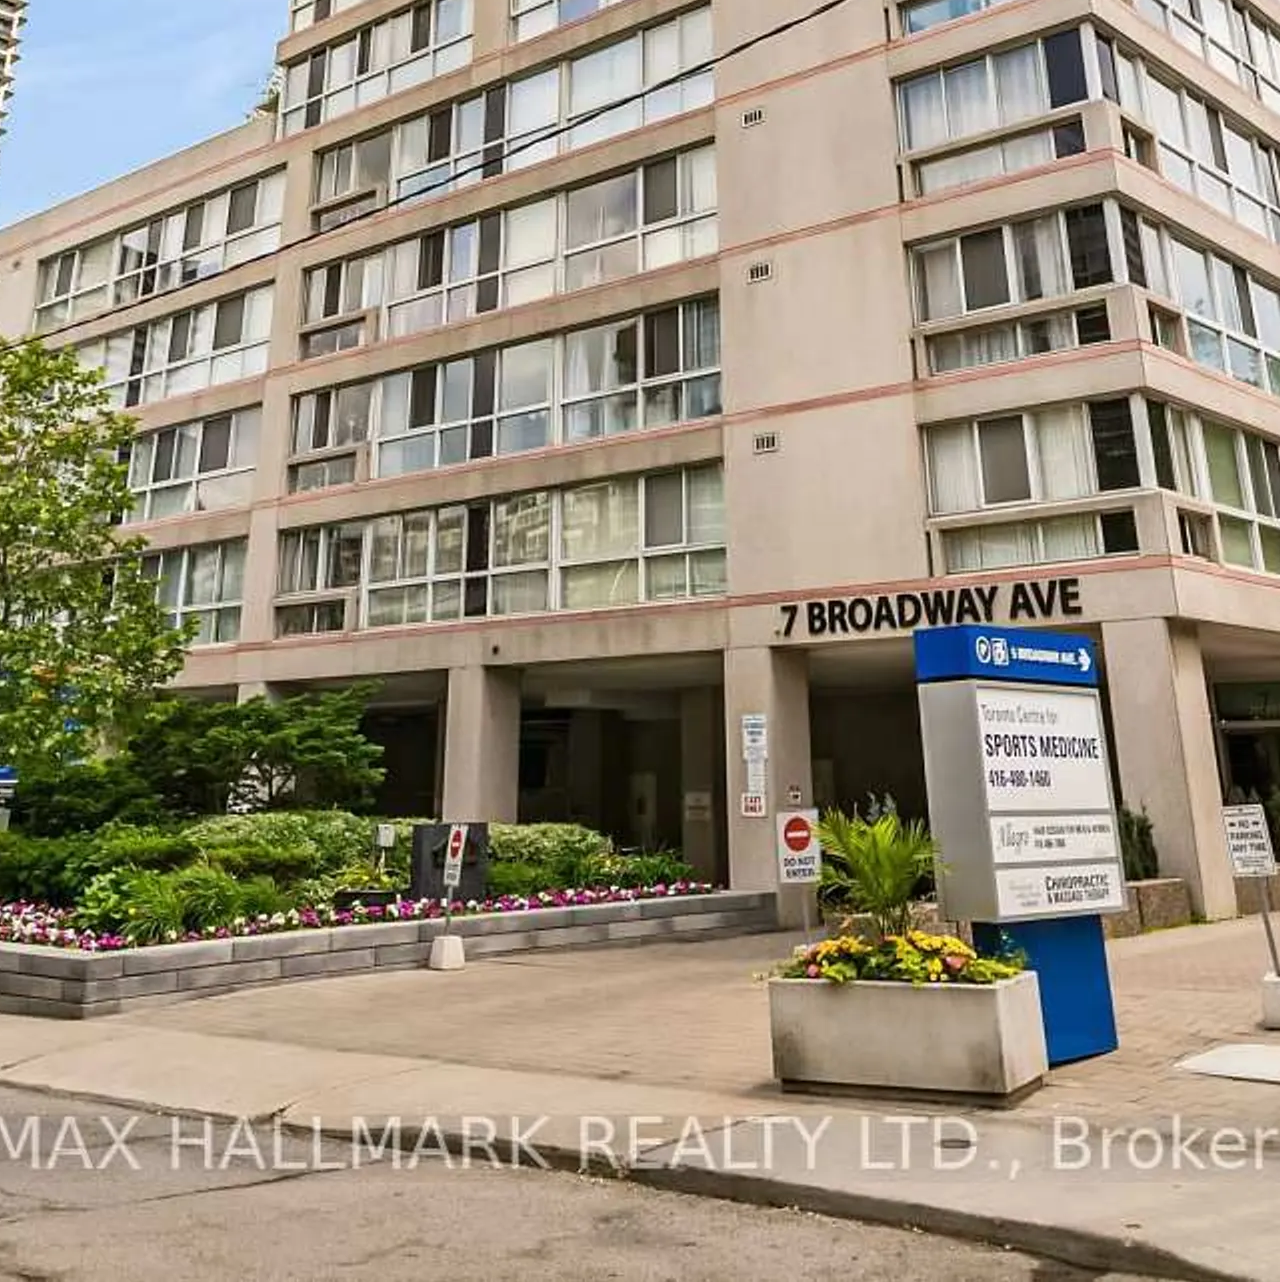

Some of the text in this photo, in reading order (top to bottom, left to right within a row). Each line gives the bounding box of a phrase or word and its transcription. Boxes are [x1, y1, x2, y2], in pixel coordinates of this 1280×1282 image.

[780, 578, 1083, 637] 7 BROADWAY AVE
[984, 734, 1099, 759] SPORTS MEDICINE
[784, 856, 815, 868] DO NOT
[786, 868, 816, 879] ENTER
